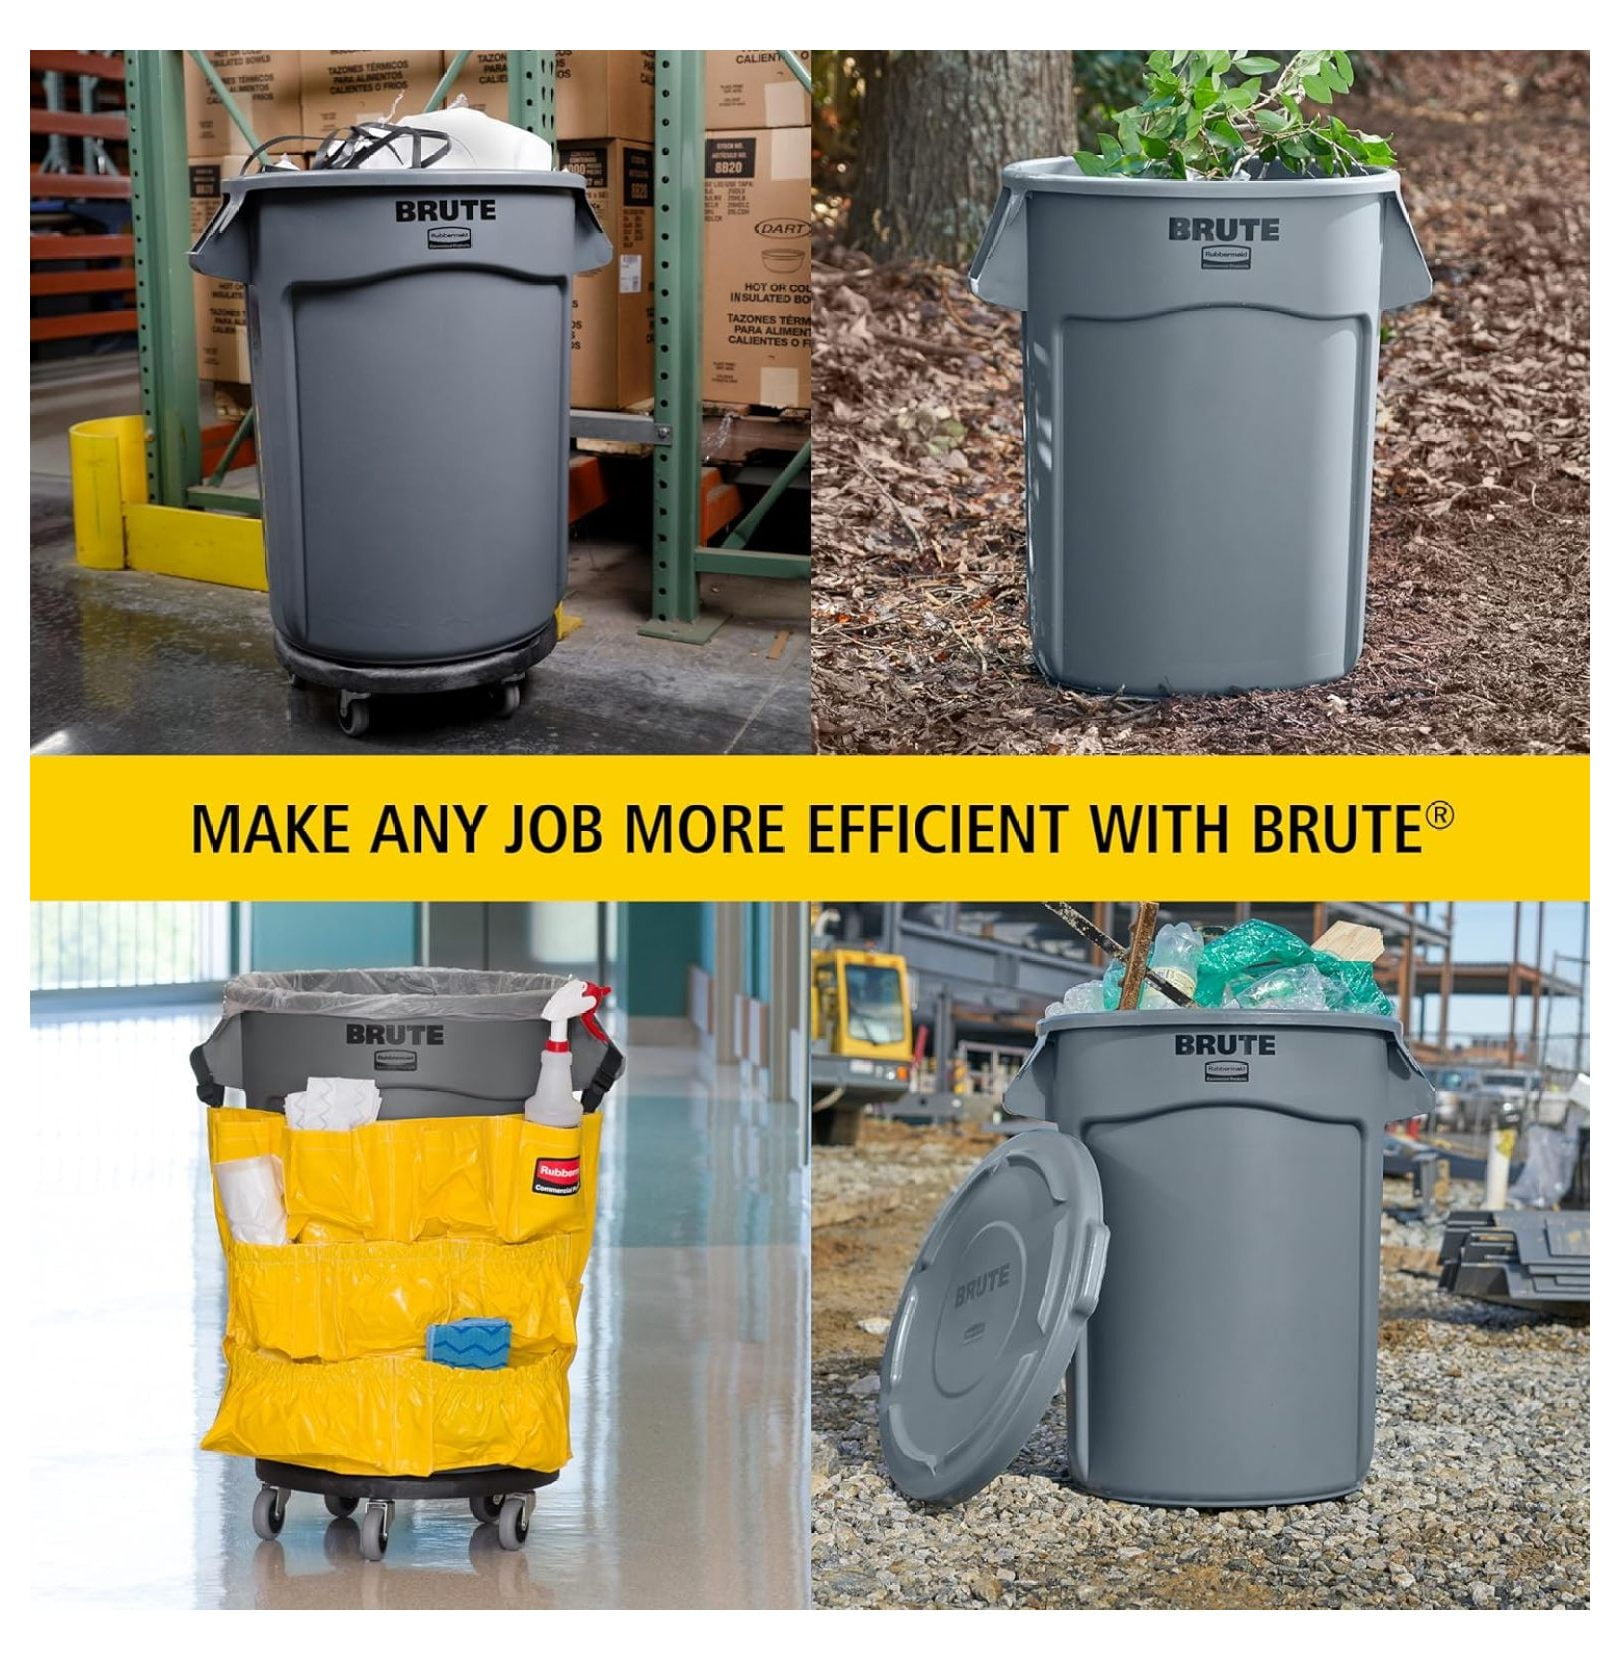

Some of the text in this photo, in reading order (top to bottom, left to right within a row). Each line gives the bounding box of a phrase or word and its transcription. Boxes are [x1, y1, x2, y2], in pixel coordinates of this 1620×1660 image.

[328, 65, 363, 75] TAZONES
[357, 71, 403, 83] ALIMENTOS
[329, 83, 373, 95] CALIENTES
[383, 81, 408, 91] FRIOS
[395, 199, 497, 222] BRUTE
[762, 223, 806, 234] DART
[1168, 217, 1280, 241] BRUTE
[745, 282, 768, 292] HOT
[769, 284, 786, 292] OR
[730, 292, 791, 304] INSULATED
[727, 313, 777, 325] TAZONES
[734, 325, 763, 334] PARA
[728, 335, 788, 346] CALIENTES
[790, 338, 800, 347] O
[346, 1024, 444, 1046] BRUTE
[1175, 1034, 1276, 1056] BRUTE
[535, 1184, 573, 1194] Commercial
[955, 1262, 1010, 1308] BRUTE
